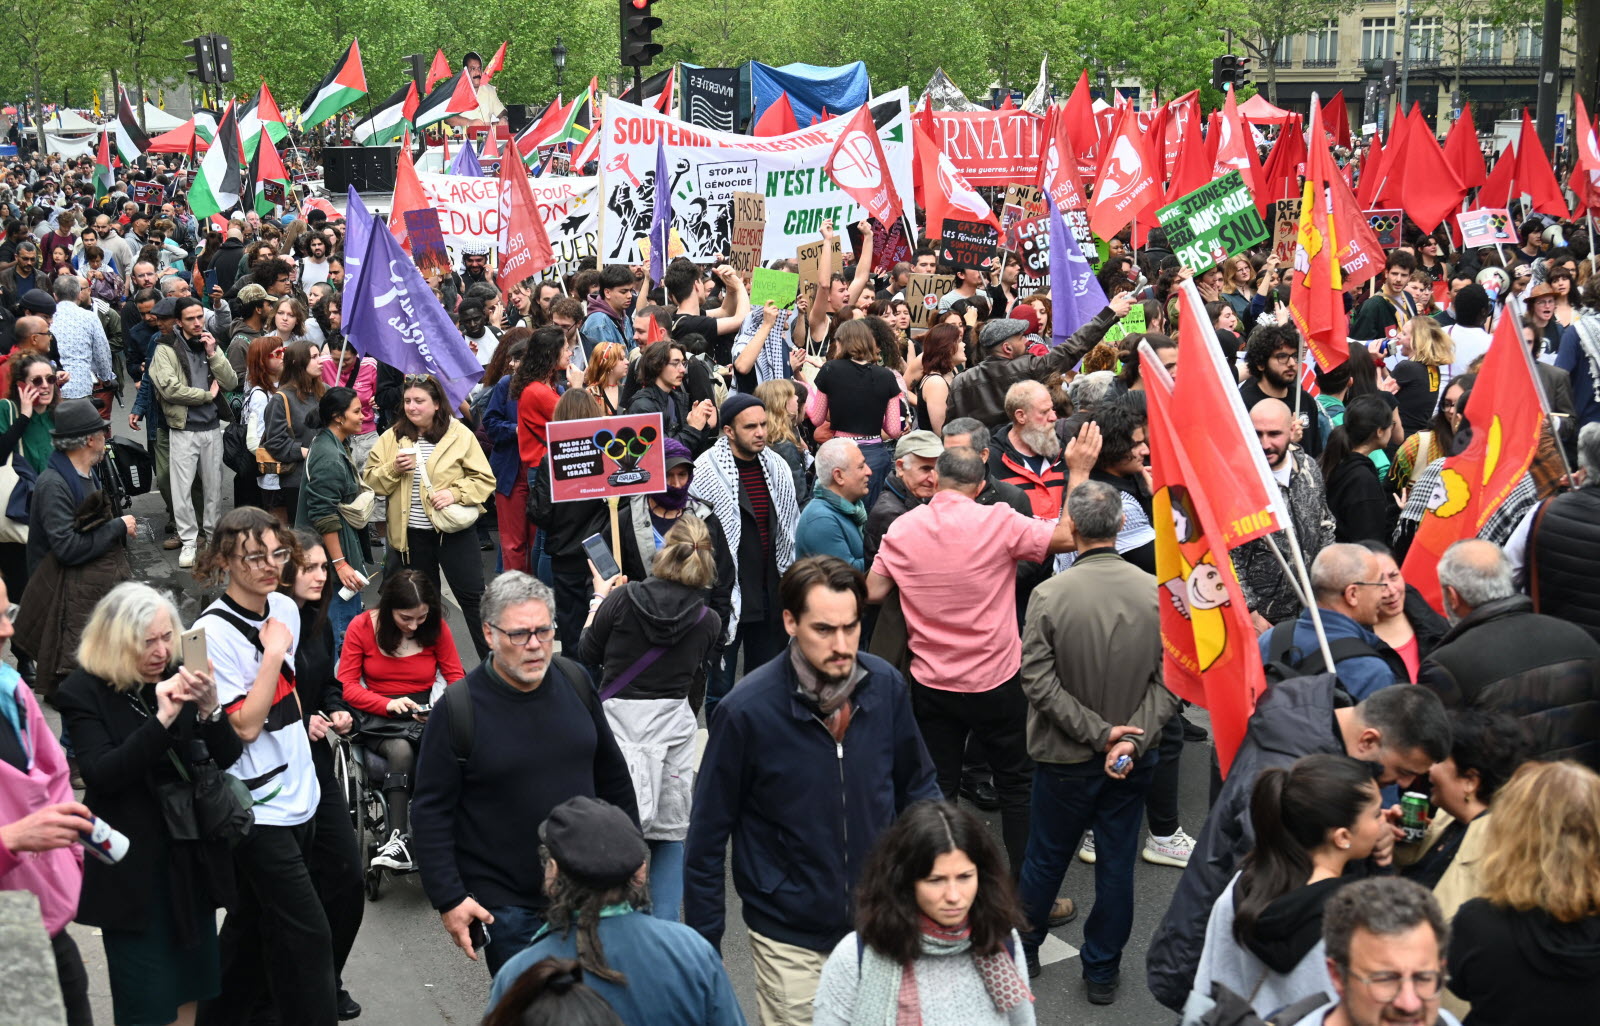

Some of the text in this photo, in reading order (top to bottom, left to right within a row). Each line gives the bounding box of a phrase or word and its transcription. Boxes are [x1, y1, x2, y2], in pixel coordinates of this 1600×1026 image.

[708, 165, 748, 177] STOP AU
[704, 178, 753, 189] GÉNOCIDE
[533, 183, 577, 201] POUR
[1016, 188, 1029, 199] NI
[1181, 172, 1244, 215] JEUNESSE
[1222, 187, 1254, 215] RUE
[1278, 200, 1294, 211] DE
[738, 198, 763, 222] PAS DE
[1158, 206, 1181, 224] NOTRE
[957, 222, 985, 235] GAZA
[1017, 222, 1038, 239] LA
[1163, 216, 1188, 237] ELLE
[1219, 208, 1265, 254] SNU
[943, 230, 997, 246] LES Féministes
[1169, 229, 1196, 249] SERA
[730, 250, 742, 272] PAS
[742, 252, 750, 272] DE
[957, 250, 979, 265] TOI
[1176, 240, 1213, 273] PAS
[1208, 238, 1222, 253] AU
[559, 441, 571, 449] PAS
[553, 451, 597, 460] GÉNOCIDAIRES
[562, 461, 595, 471] BOYCOTT
[567, 468, 592, 477] ISRAËL
